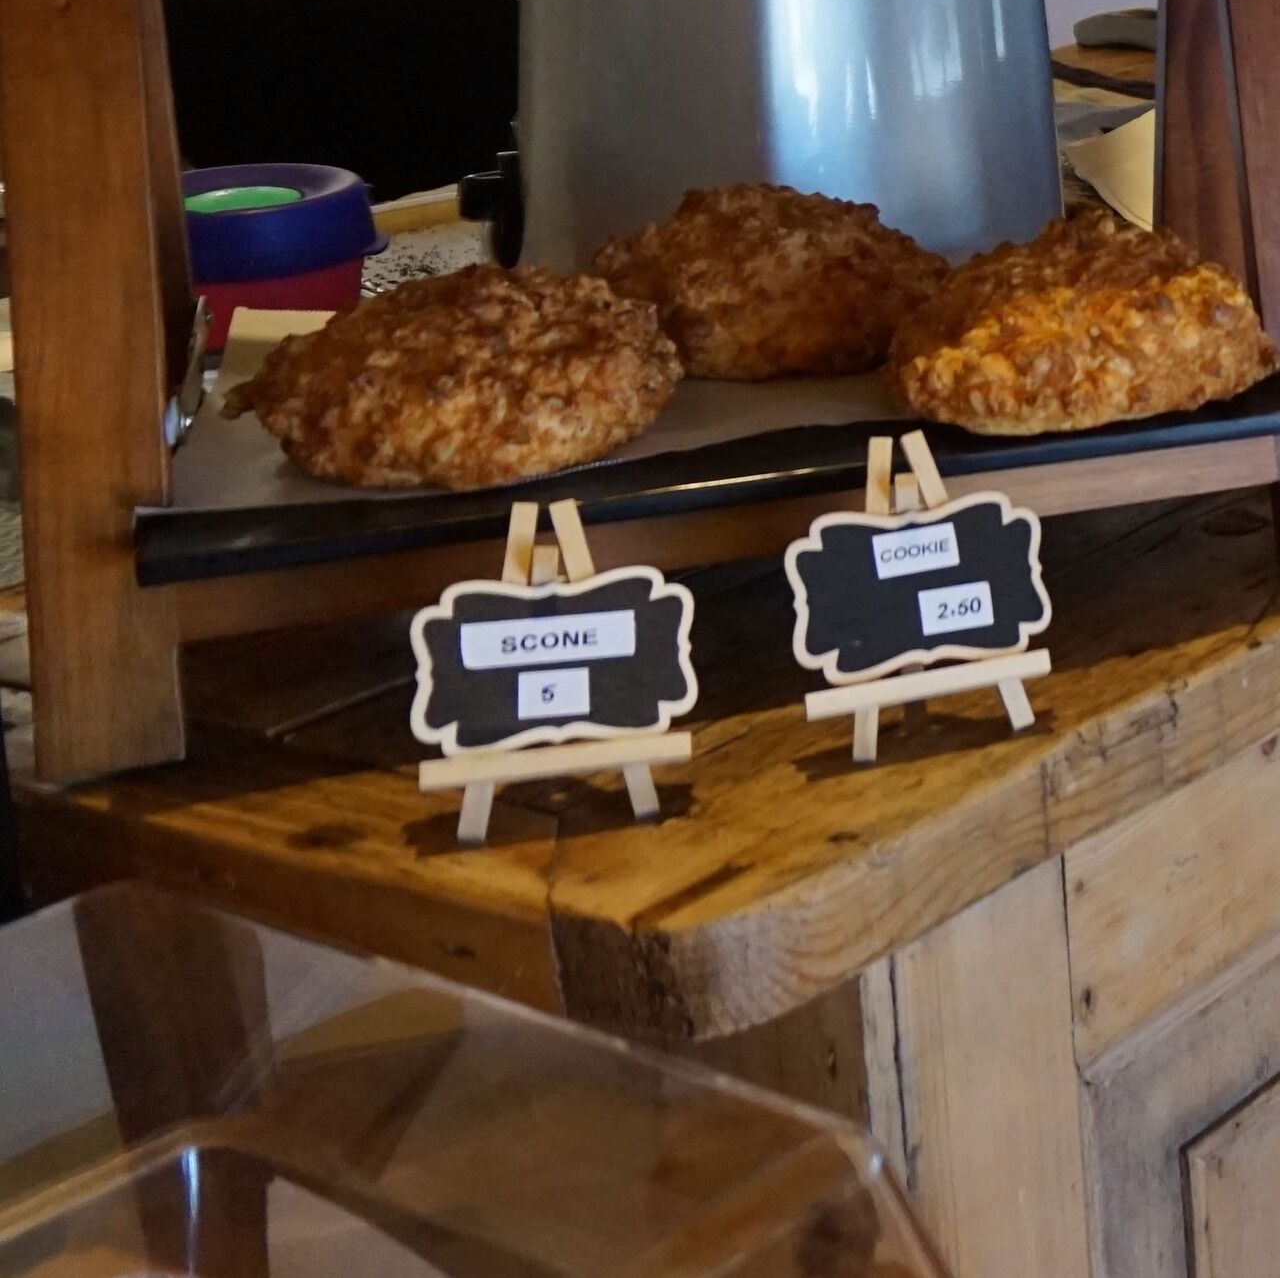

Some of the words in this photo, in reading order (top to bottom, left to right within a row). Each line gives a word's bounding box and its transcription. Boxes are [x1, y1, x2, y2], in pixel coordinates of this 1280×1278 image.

[880, 537, 951, 564] COOKIE
[937, 596, 982, 620] 2.50
[501, 627, 599, 654] SCONE
[541, 682, 557, 704] 5
